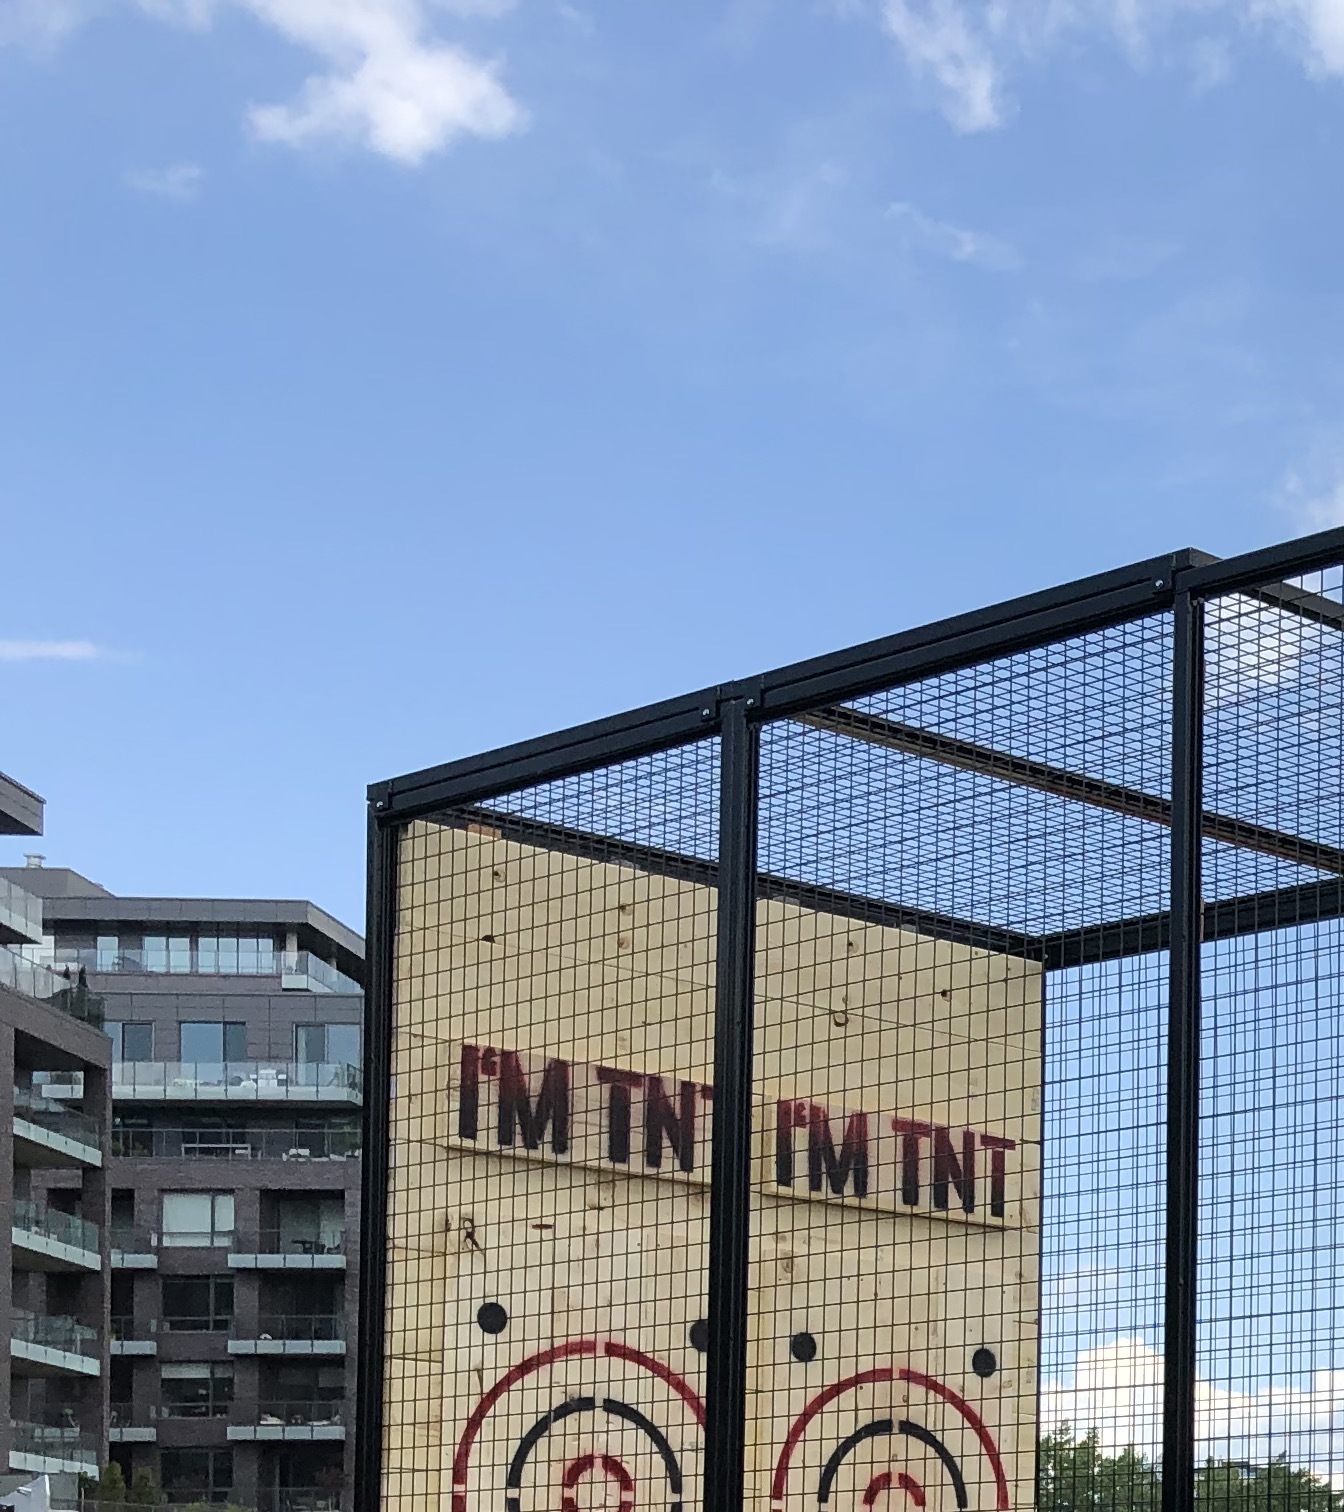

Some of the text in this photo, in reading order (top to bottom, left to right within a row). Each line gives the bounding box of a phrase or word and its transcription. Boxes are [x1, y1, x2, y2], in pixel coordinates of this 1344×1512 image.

[458, 1044, 715, 1173] I'M TN
[776, 1100, 1016, 1217] I'M TNT
